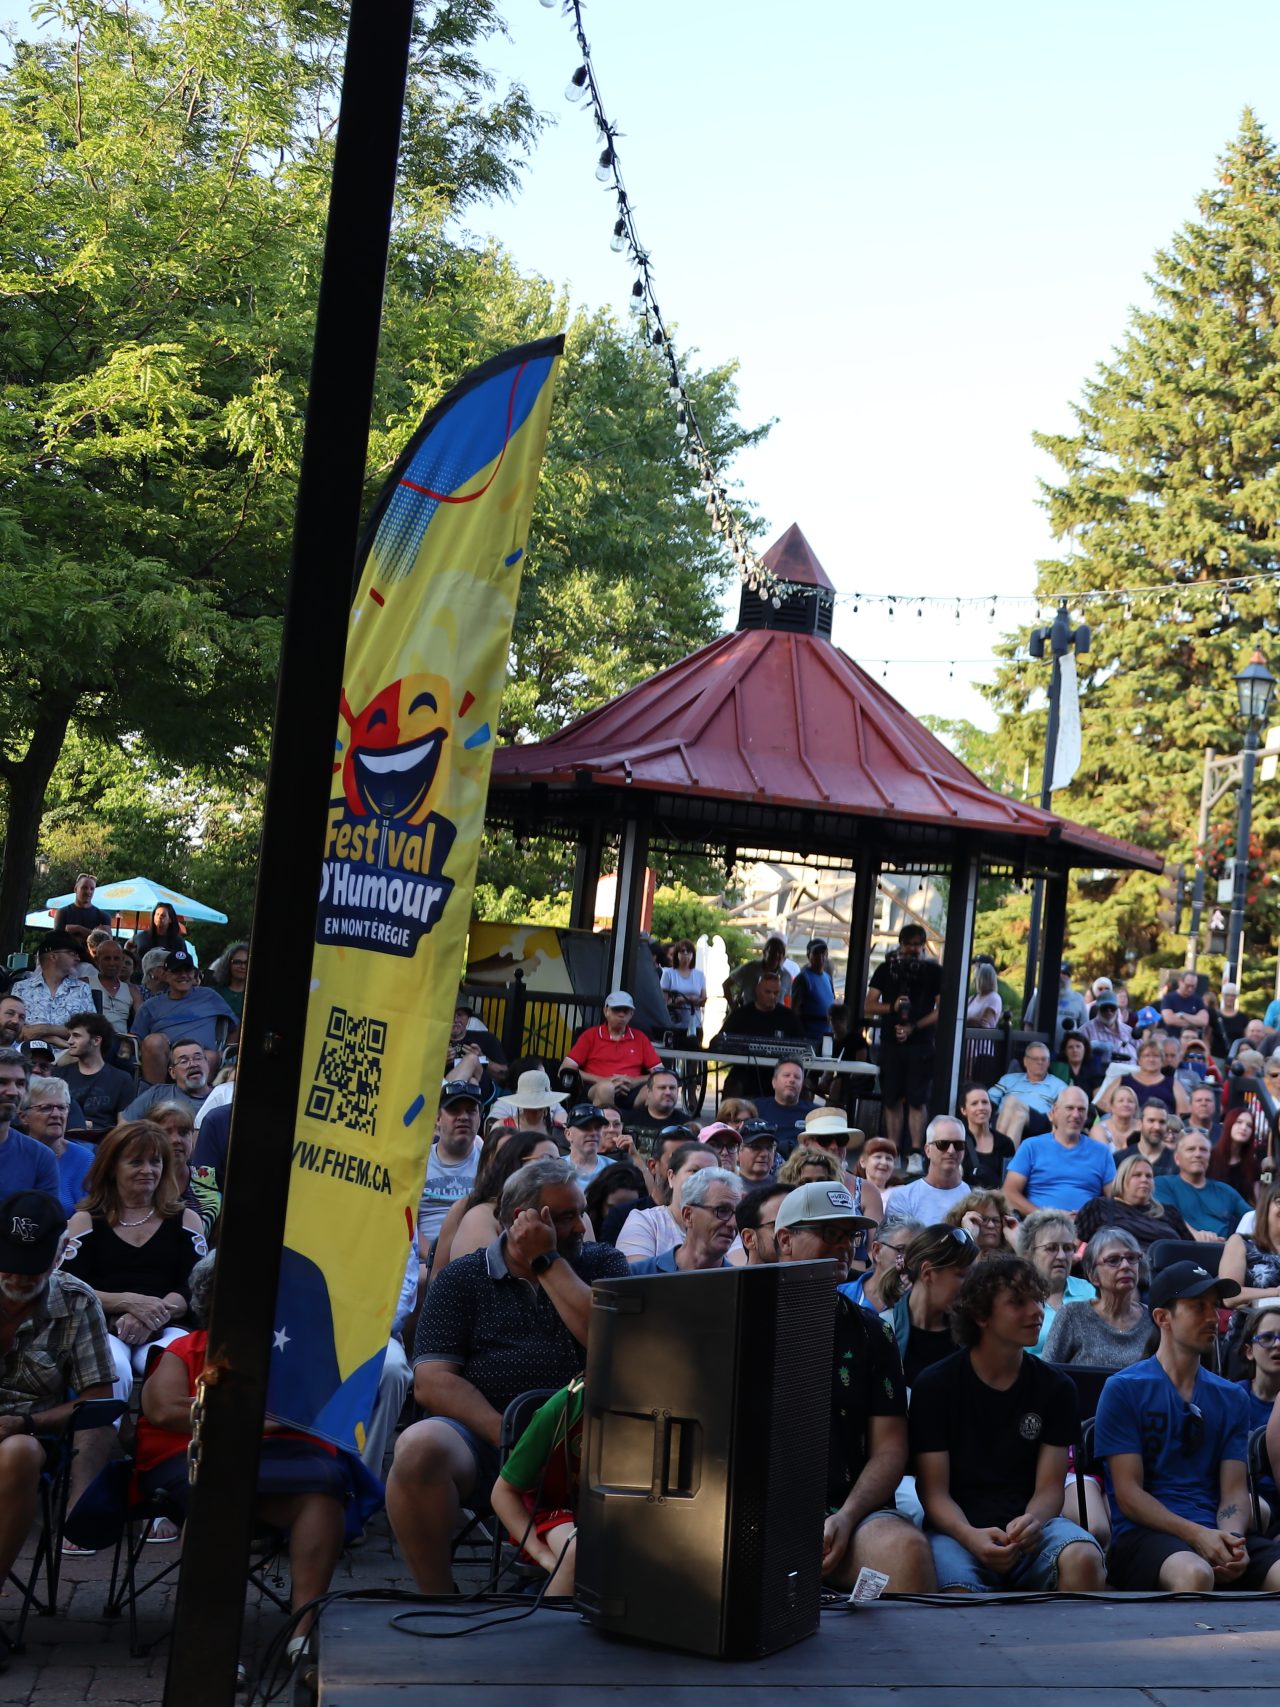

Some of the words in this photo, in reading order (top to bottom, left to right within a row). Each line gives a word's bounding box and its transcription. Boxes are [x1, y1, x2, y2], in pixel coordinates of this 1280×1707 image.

[325, 917, 339, 935] EN
[341, 917, 410, 947] MONTÉRÉGIE
[10, 1216, 40, 1242] NY
